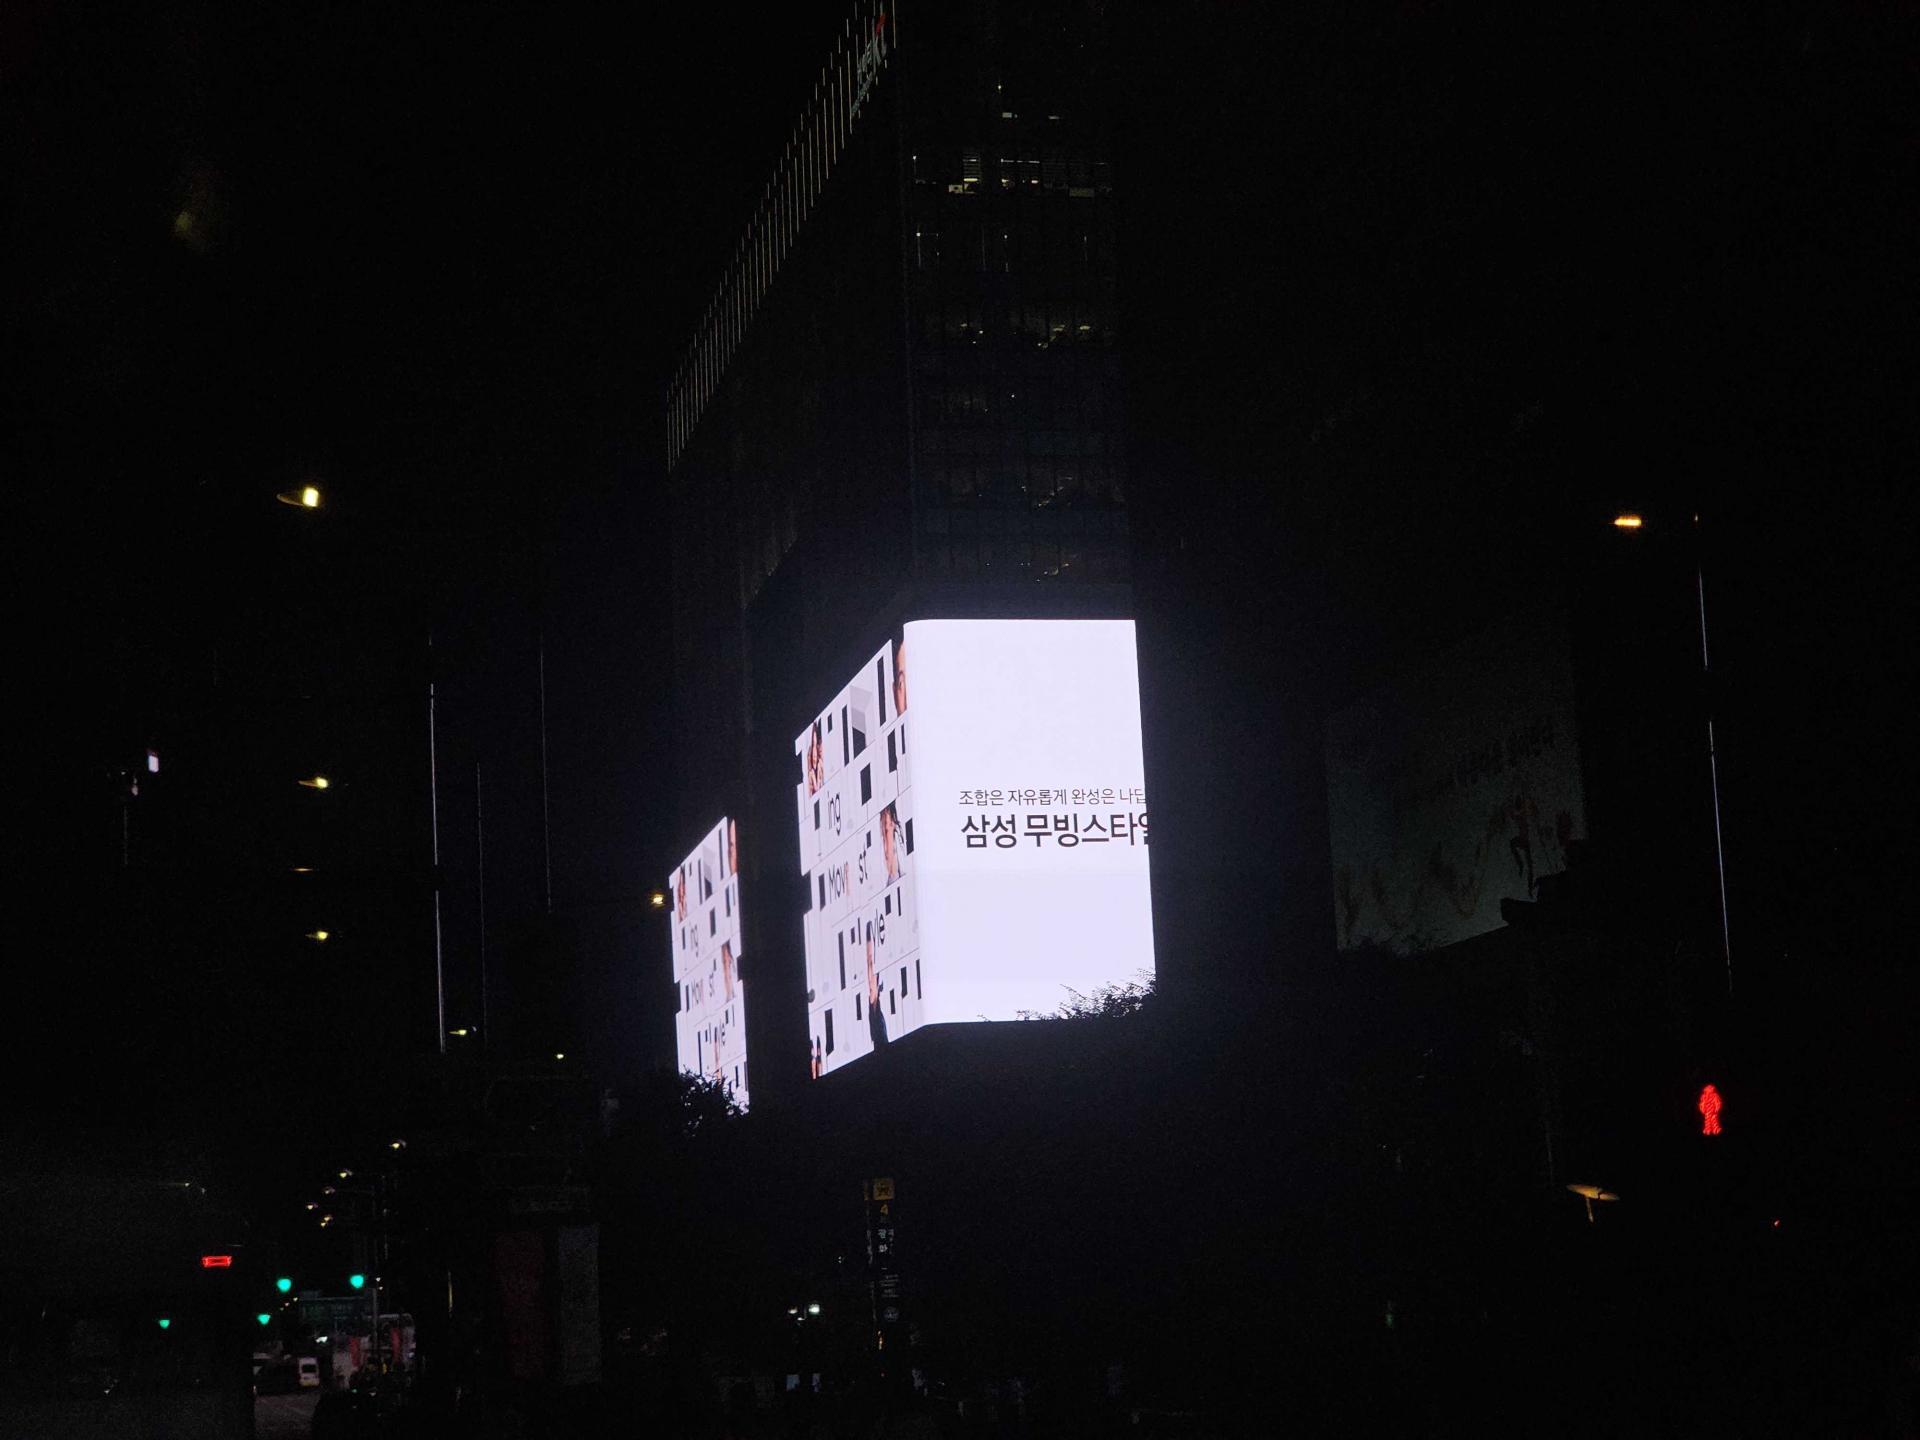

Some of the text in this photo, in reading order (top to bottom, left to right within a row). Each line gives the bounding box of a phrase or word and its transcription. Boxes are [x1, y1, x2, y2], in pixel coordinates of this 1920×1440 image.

[959, 788, 1004, 805] 조합은
[1007, 788, 1067, 806] 자유롭게
[1071, 788, 1115, 805] 완성은
[960, 813, 1017, 849] 삼성
